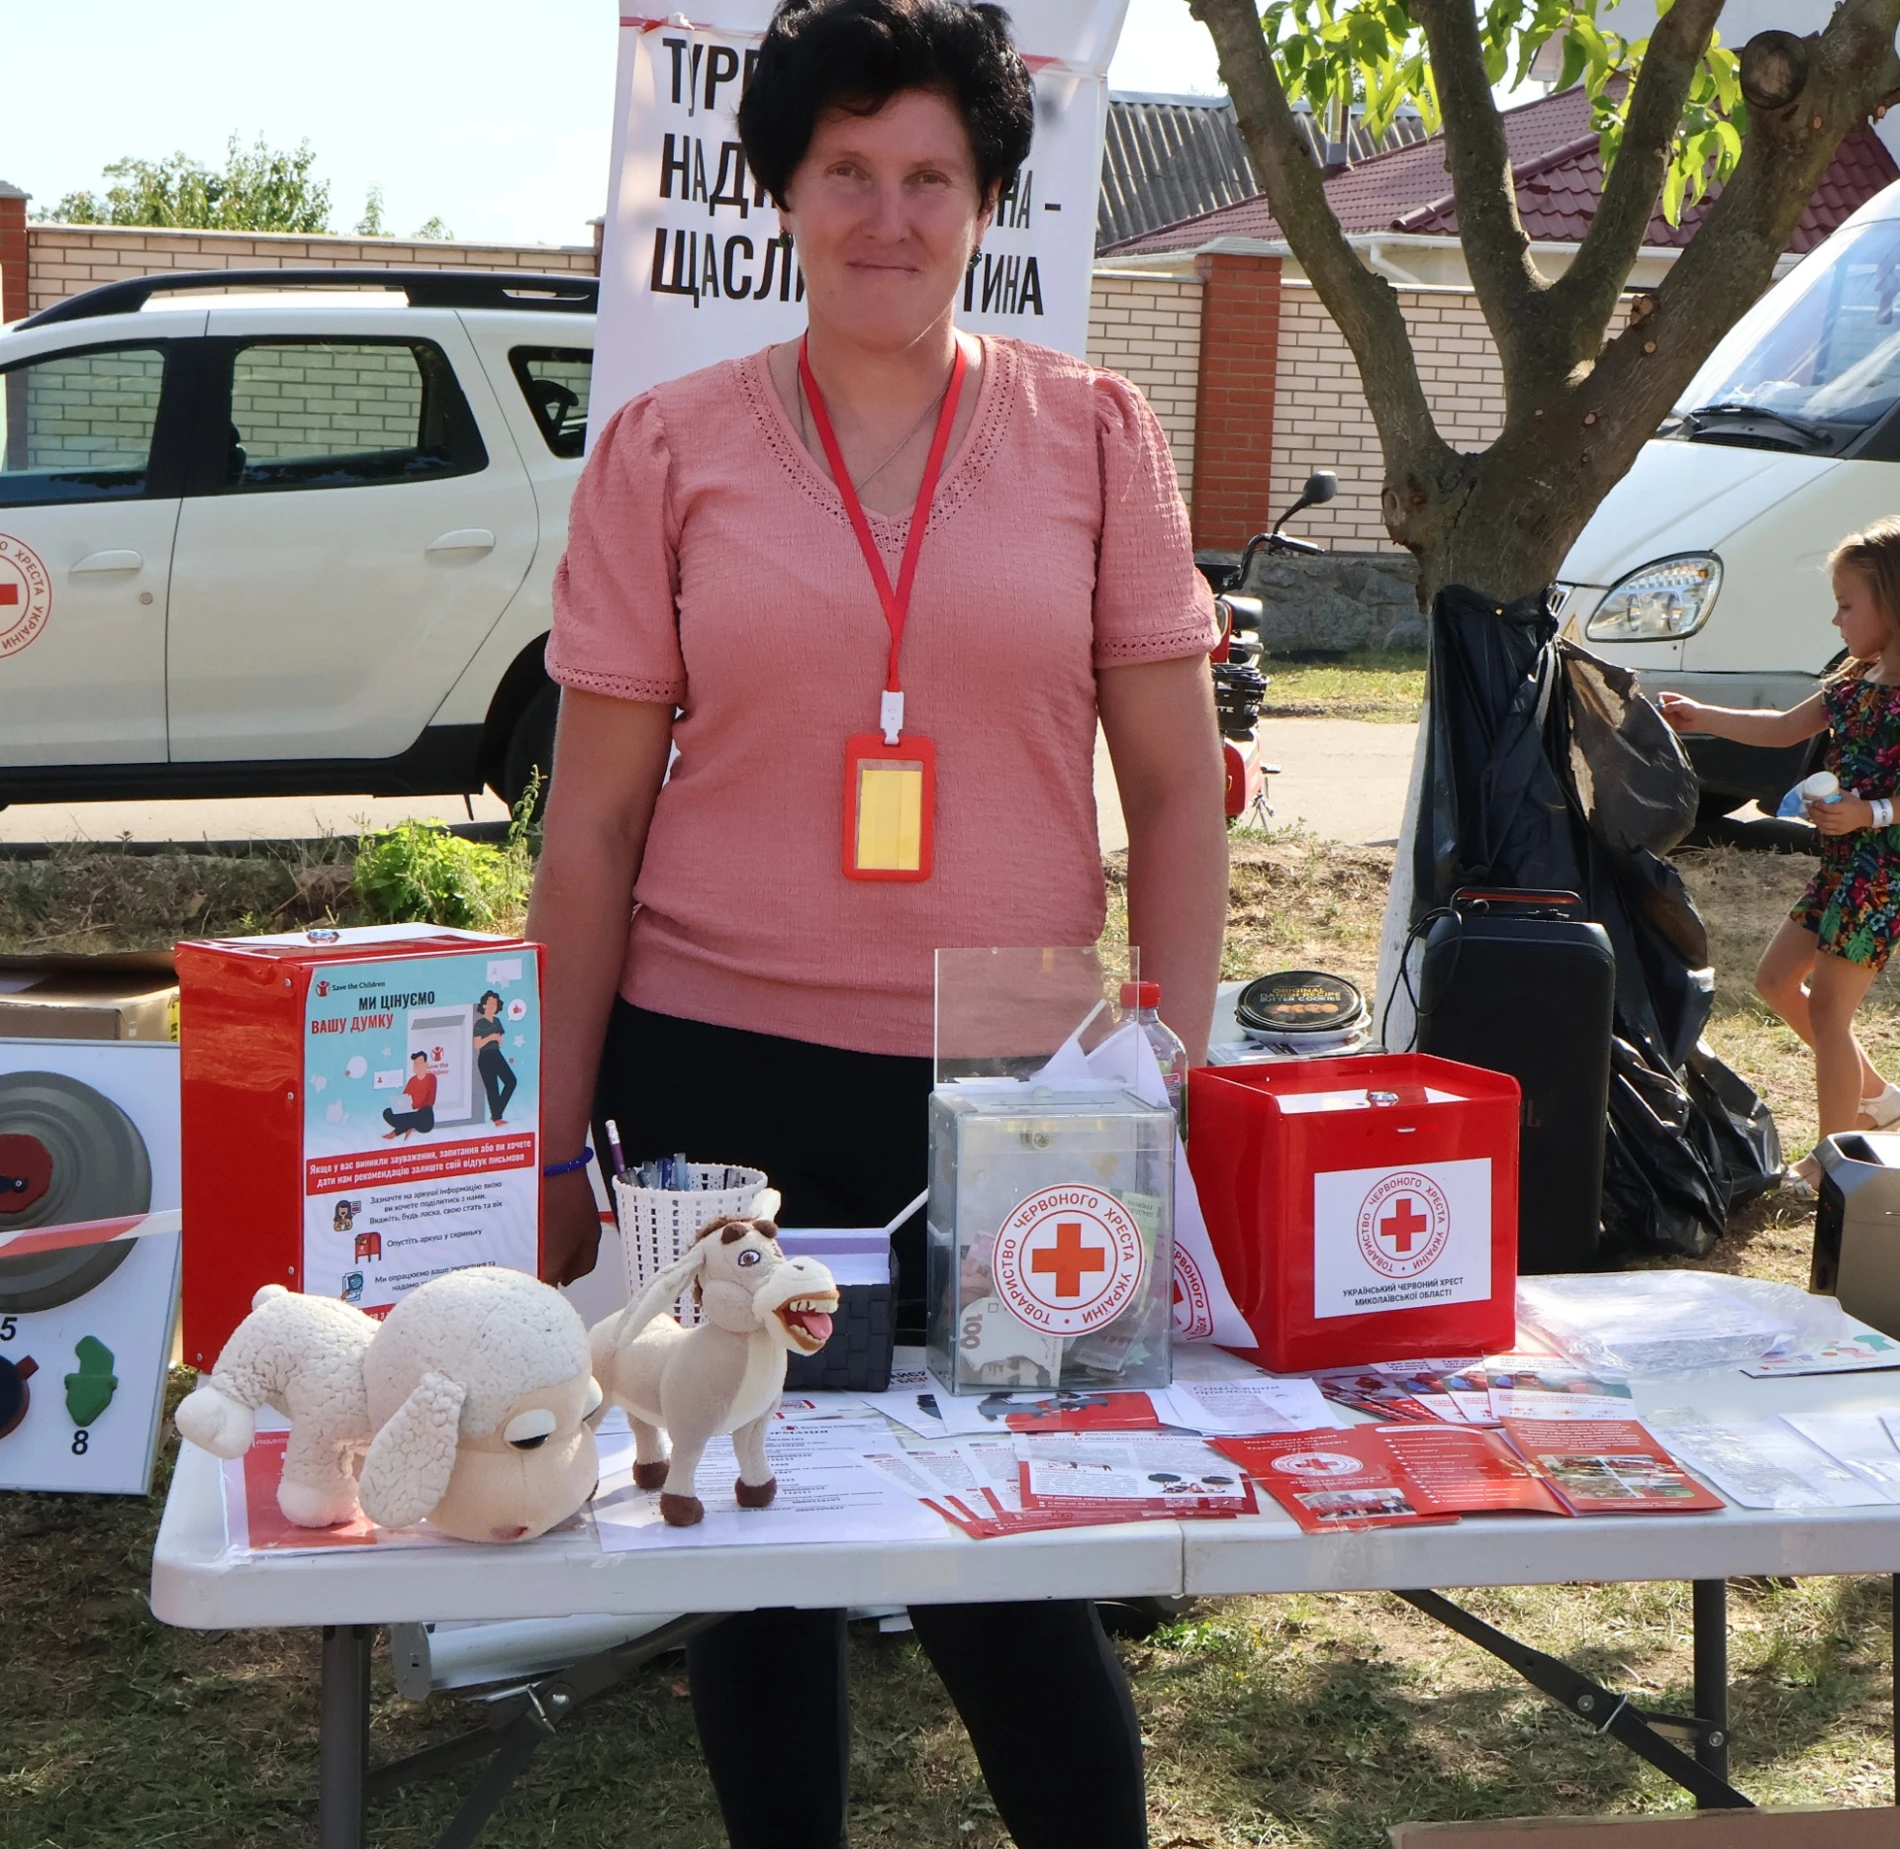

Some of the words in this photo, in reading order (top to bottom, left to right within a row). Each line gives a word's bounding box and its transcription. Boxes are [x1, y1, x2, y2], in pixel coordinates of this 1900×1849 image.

[662, 38, 761, 116] ТУР
[997, 168, 1032, 229] НА
[14, 549, 45, 596] ХРЕСТА
[2, 606, 44, 650] УКРАЇНИ
[359, 981, 386, 989] Children
[359, 996, 377, 1011] МИ
[380, 991, 435, 1011] ЦІНУЄМО
[311, 1018, 347, 1034] ВАШУ
[350, 1013, 394, 1033] ДУМКУ
[310, 1164, 332, 1175] Якщо
[439, 1147, 479, 1158] запитання
[480, 1143, 494, 1153] або
[496, 1143, 505, 1151] ви
[507, 1140, 531, 1150] хочете
[337, 1175, 352, 1184] нам
[463, 1158, 487, 1168] відгук
[1369, 1177, 1422, 1206] ЧЕРВОНОГО
[1425, 1186, 1446, 1224] ХРЕСТА
[1013, 1193, 1099, 1231] ЧЕРВОНОГО
[1103, 1207, 1135, 1262] ХРЕСТА
[1362, 1212, 1394, 1273] ТОВАРИСТВО
[1413, 1232, 1445, 1270] УКРАЇНИ
[1001, 1239, 1051, 1326] ТОВАРИСТВО
[1174, 1248, 1204, 1308] РВОНОГО
[1343, 1283, 1396, 1298] УКРАЇНСЬКИЙ
[1397, 1279, 1439, 1292] ЧЕРВОНИЙ
[1440, 1277, 1464, 1286] ХРЕСТ
[1354, 1291, 1418, 1306] МИКОЛАЇВСЬКОЇ
[1419, 1288, 1452, 1300] ОБЛАСТІ
[1082, 1272, 1133, 1325] УКРАЇНИ
[0, 1317, 18, 1342] 5
[960, 1314, 983, 1350] 100
[71, 1430, 90, 1456] 8
